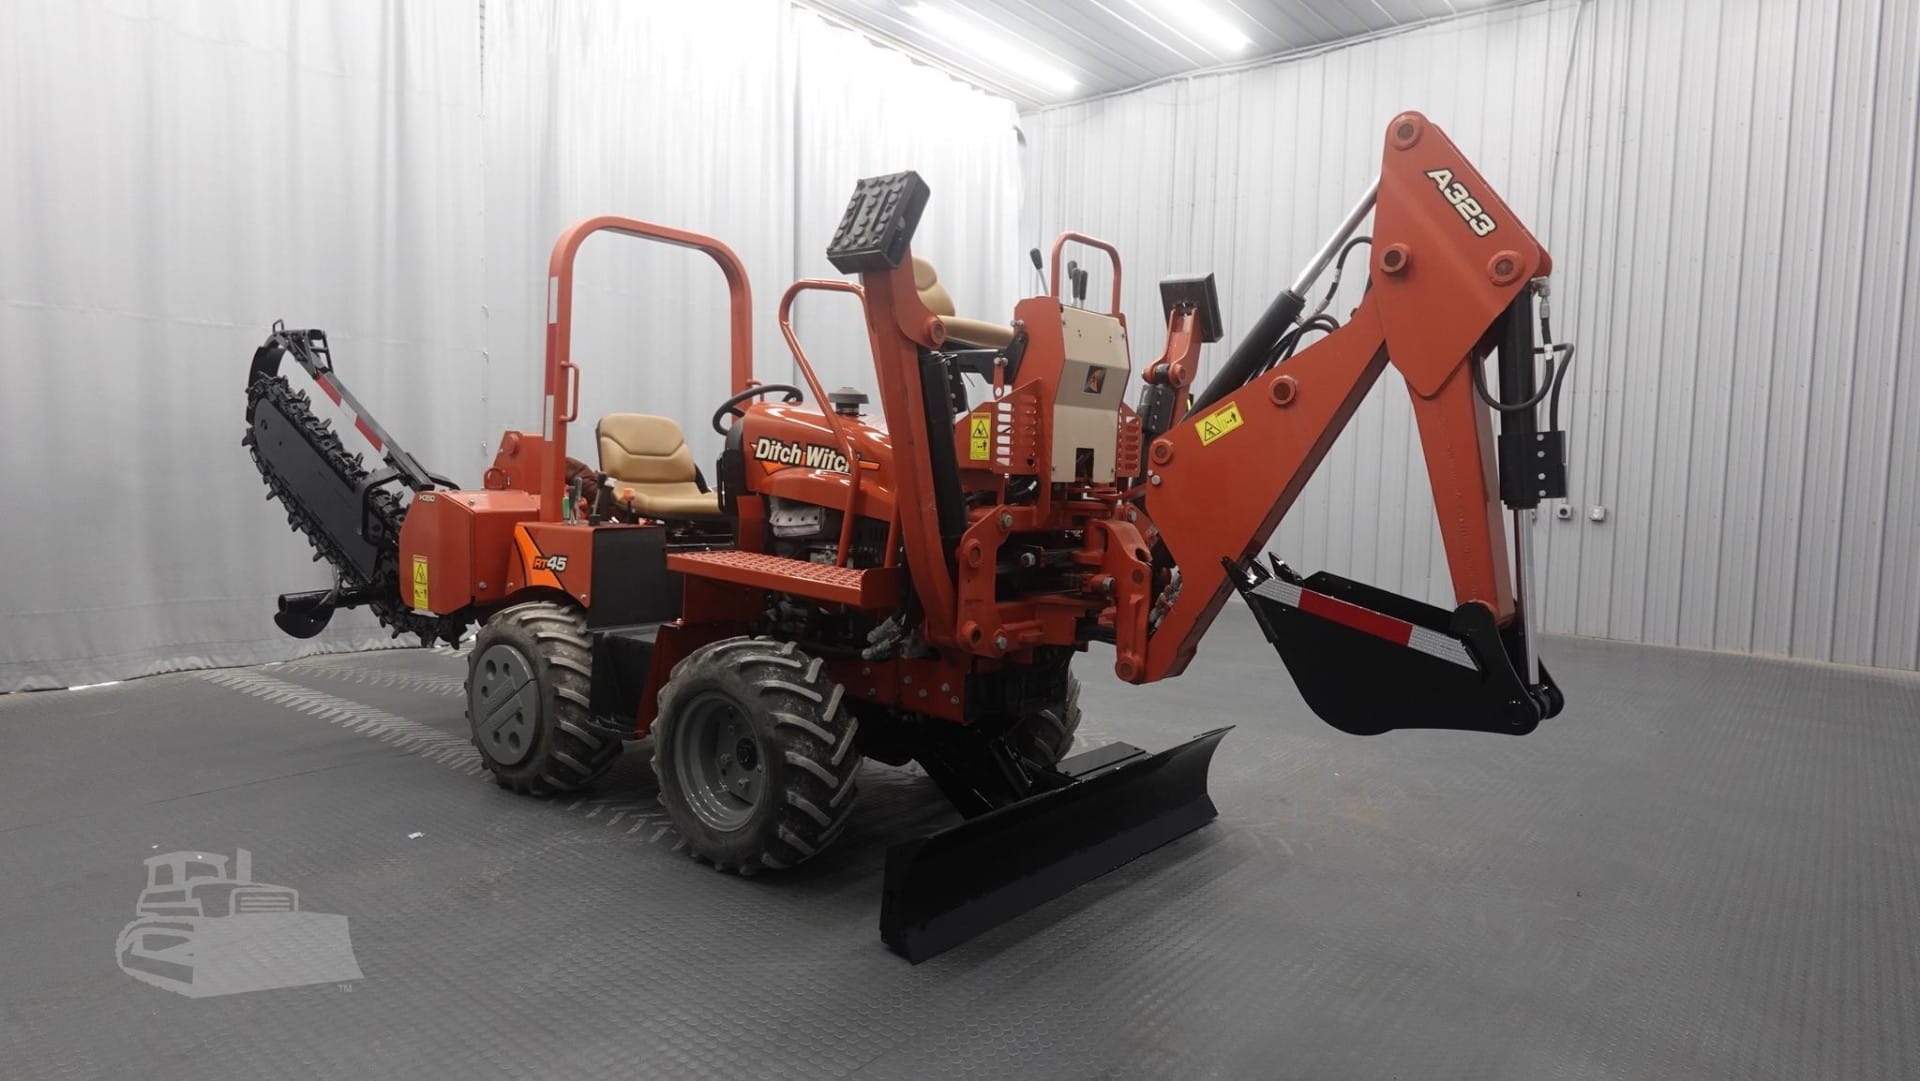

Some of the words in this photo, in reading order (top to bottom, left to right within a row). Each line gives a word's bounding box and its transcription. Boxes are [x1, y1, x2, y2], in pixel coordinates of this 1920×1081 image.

[1425, 168, 1497, 236] A323
[755, 438, 802, 465] Ditch
[534, 555, 568, 571] RT45
